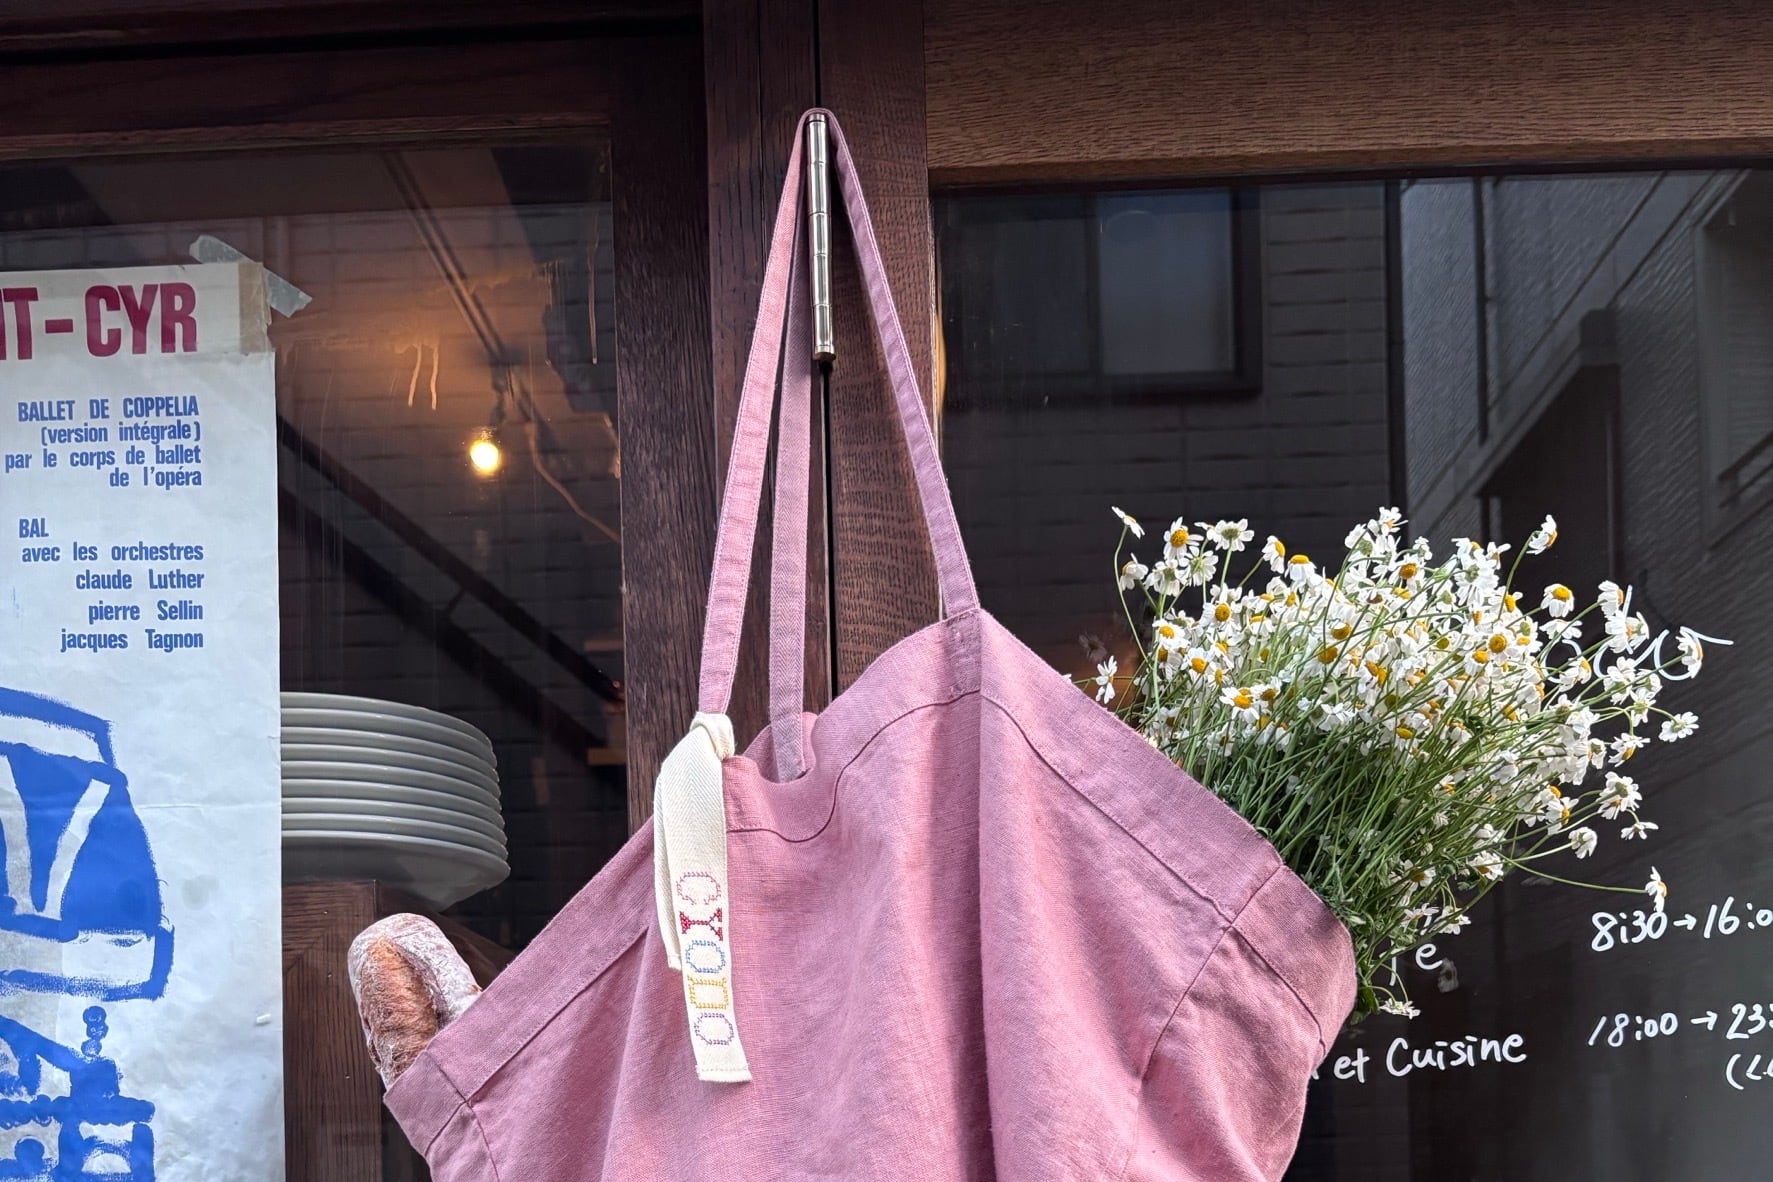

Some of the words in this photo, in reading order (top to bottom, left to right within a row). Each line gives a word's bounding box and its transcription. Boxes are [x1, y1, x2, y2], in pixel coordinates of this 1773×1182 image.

[0, 282, 198, 360] T-CYR
[17, 400, 75, 422] BALLET
[89, 399, 110, 419] DE
[122, 395, 199, 418] COPPELIA
[41, 422, 108, 446] (version
[118, 419, 201, 444] intégrale)
[5, 453, 33, 473] par
[42, 448, 57, 467] le
[69, 450, 115, 470] corps
[125, 445, 145, 465] de
[155, 444, 202, 464] ballet
[109, 467, 129, 487] de
[143, 466, 202, 490] l'opéra
[18, 517, 49, 538] BAL
[21, 546, 61, 562] avec
[72, 541, 98, 561] les
[111, 541, 204, 561] orchestres
[75, 569, 133, 589] claude
[148, 568, 205, 589] Luther
[88, 600, 141, 625] pierre
[156, 599, 204, 620] Sellin
[60, 628, 128, 653] jacques
[144, 628, 204, 653] Tagnon
[1591, 910, 1668, 952] 8:30
[1588, 1012, 1679, 1048] 18:00
[1333, 1048, 1370, 1084] et
[1385, 1033, 1528, 1077] Cuisine
